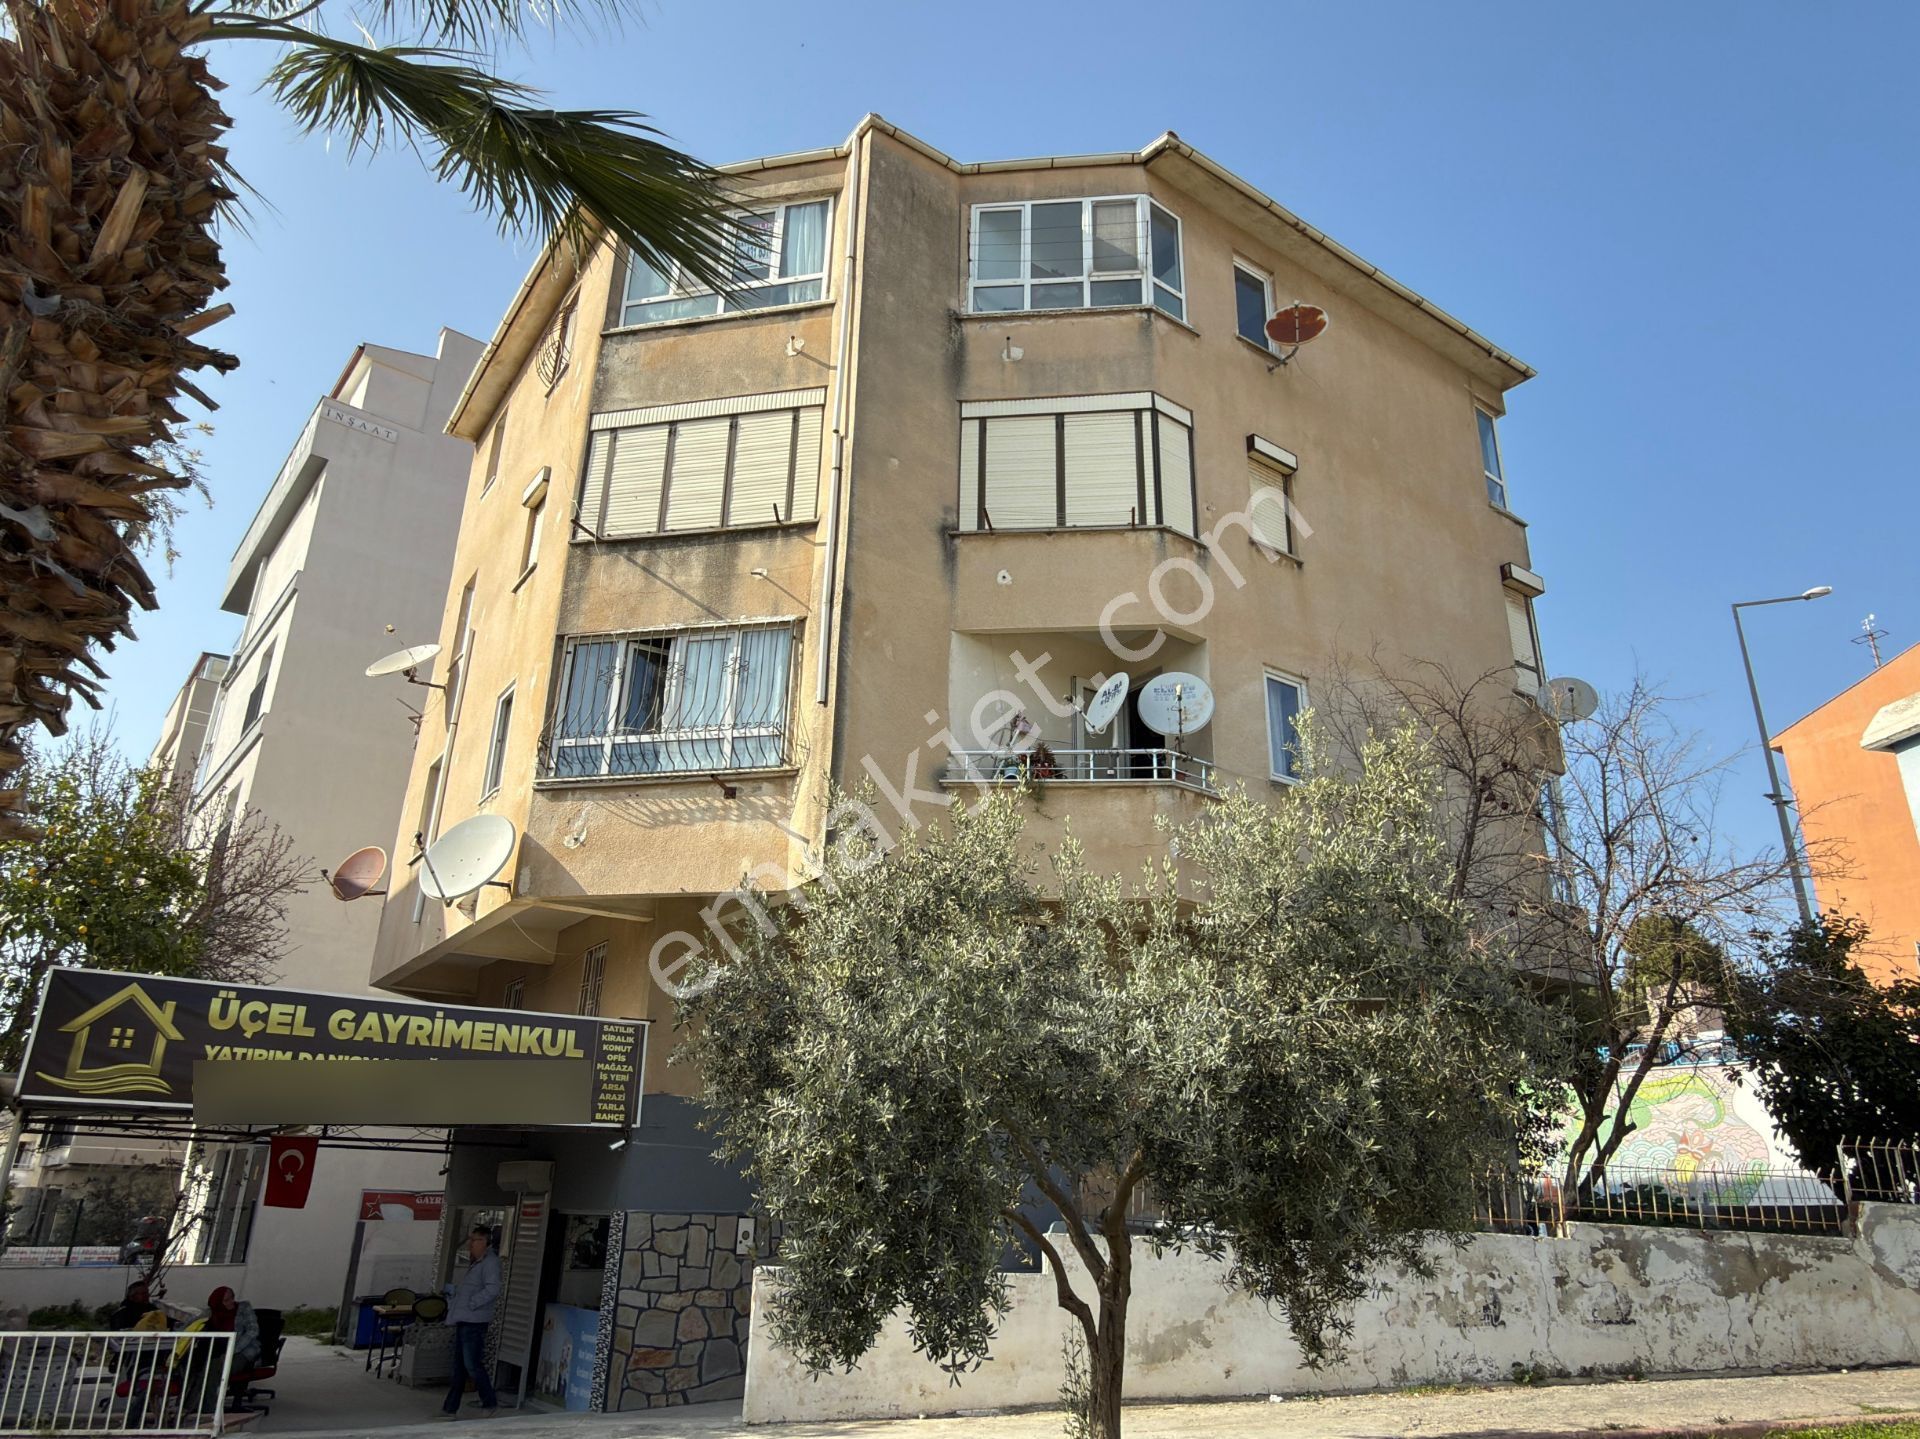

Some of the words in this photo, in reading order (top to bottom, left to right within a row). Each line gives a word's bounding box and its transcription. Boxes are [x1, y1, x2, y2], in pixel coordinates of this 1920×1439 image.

[208, 990, 315, 1039] ÜÇEL
[328, 1009, 584, 1058] GAYRİMENKUL
[603, 1024, 635, 1034] SATILIK
[601, 1033, 635, 1043] KİRALIK
[603, 1044, 632, 1053] KONUT
[607, 1053, 626, 1062] OFİS
[597, 1062, 633, 1072] MAĞAZA
[600, 1072, 608, 1081] İŞ
[610, 1072, 629, 1082] YERİ
[602, 1083, 625, 1091] ARSA
[599, 1092, 626, 1101] ARAZİ
[597, 1102, 625, 1111] TARLA
[595, 1112, 625, 1122] BAHÇE
